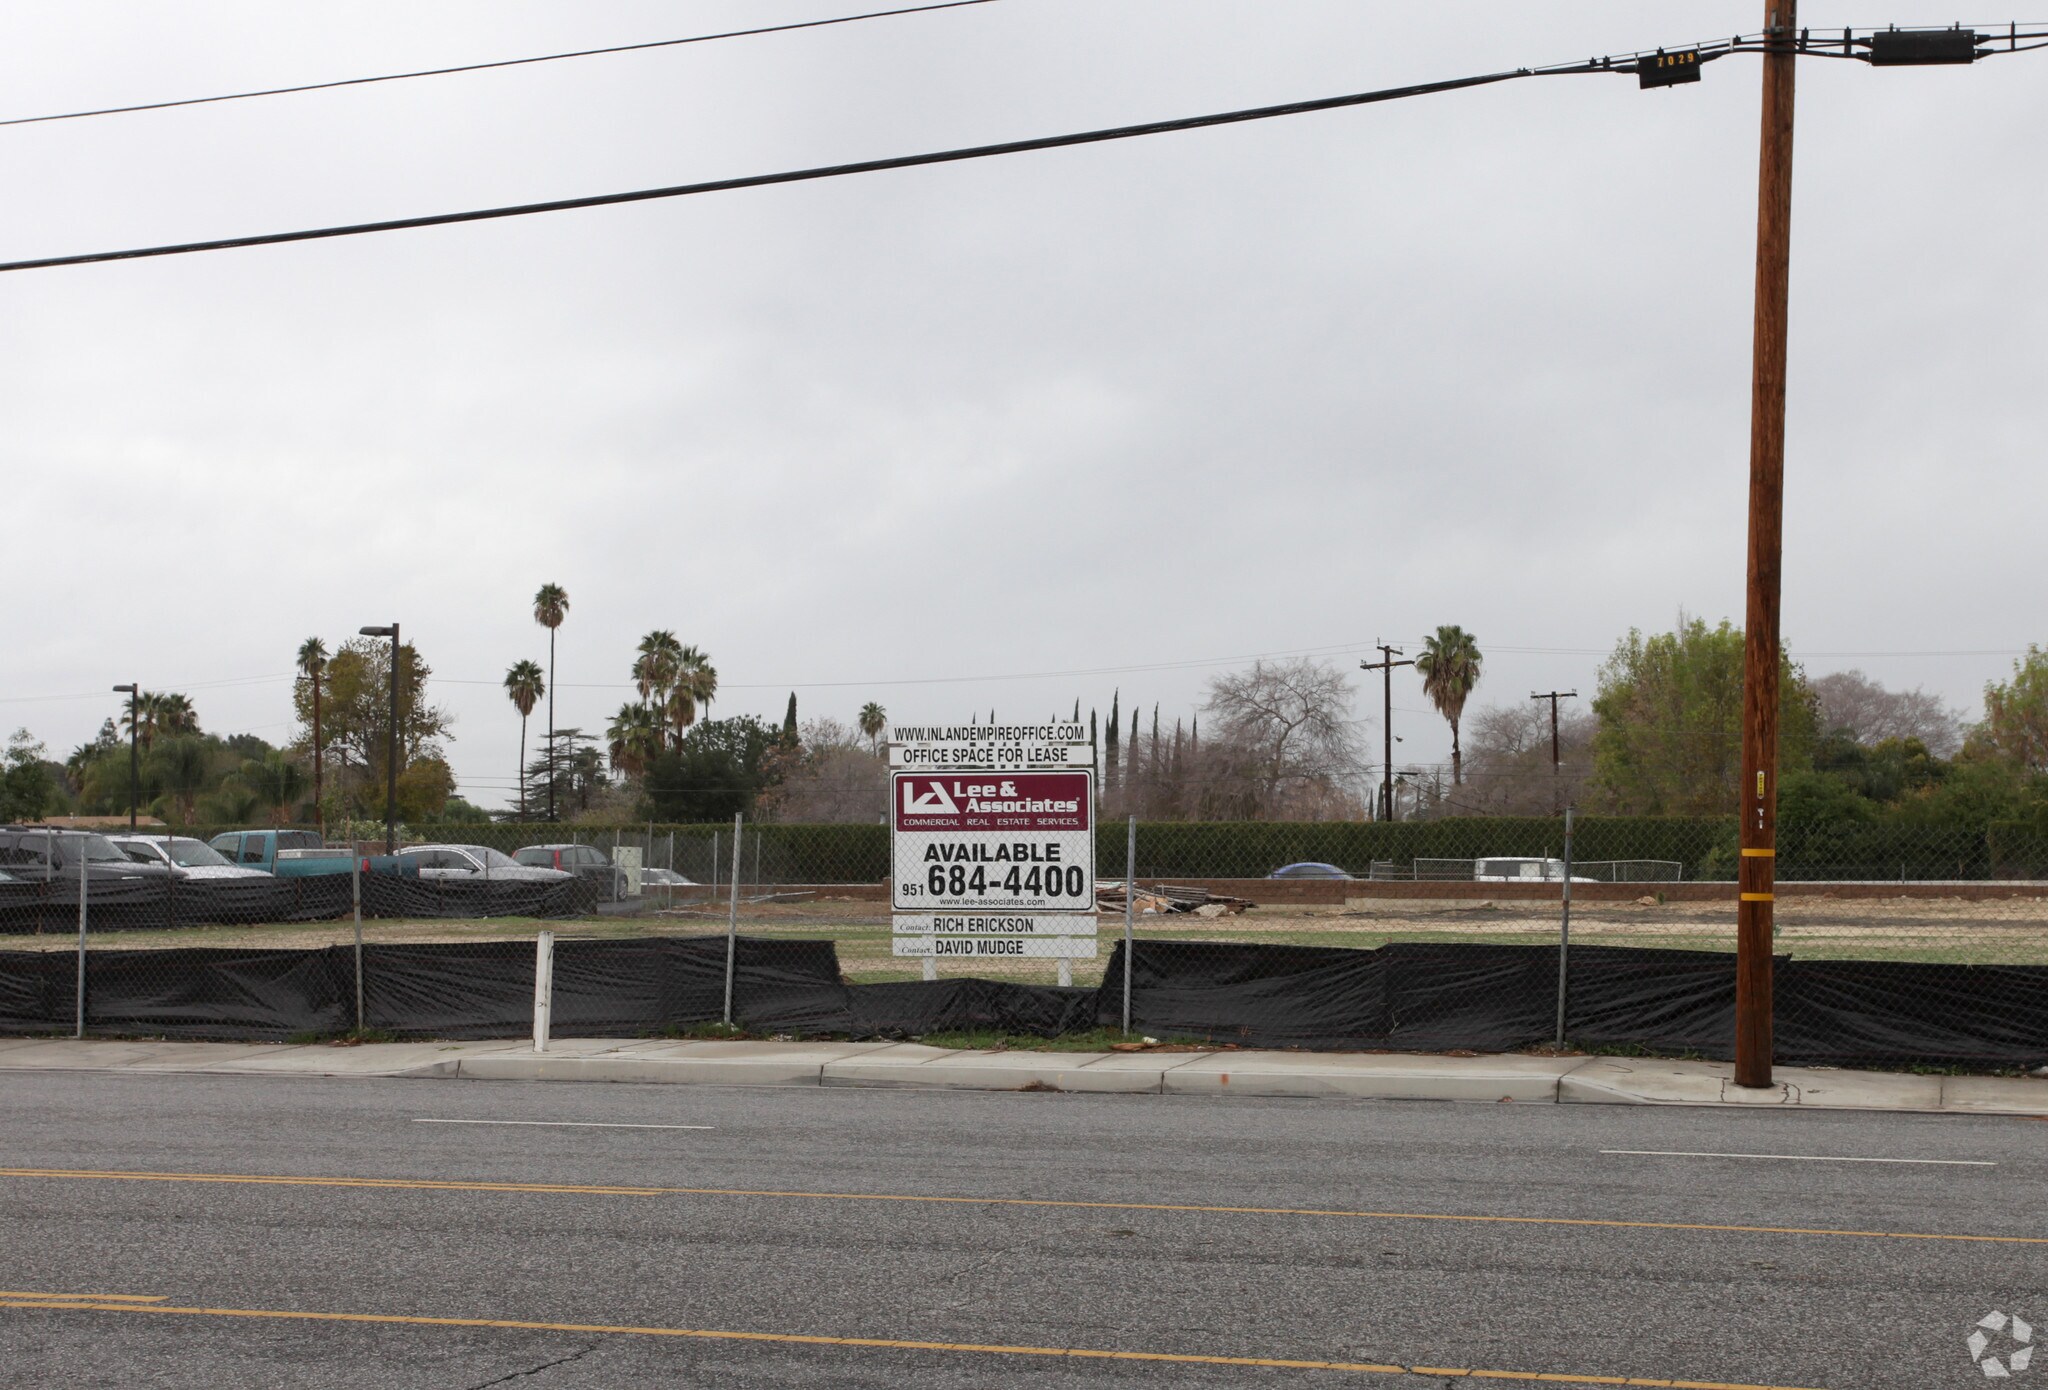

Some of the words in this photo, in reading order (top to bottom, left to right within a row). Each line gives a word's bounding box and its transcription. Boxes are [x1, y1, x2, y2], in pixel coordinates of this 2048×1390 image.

[1657, 52, 1695, 67] 7029
[894, 725, 1084, 741] WWW.INLANDEMPIREOFFICE.COM
[903, 749, 949, 763] OFFICE
[952, 748, 994, 763] SPACE
[997, 748, 1023, 762] FOR
[1027, 747, 1068, 762] LEASE
[953, 781, 997, 797] Lee
[999, 780, 1018, 797] &
[965, 797, 1078, 813] Associates
[903, 818, 960, 826] COMMERCIAL
[966, 818, 990, 826] REAL
[997, 818, 1031, 826] ESTATE
[1036, 817, 1079, 826] SERVICES
[923, 843, 1061, 862] AVAILABLE
[902, 883, 925, 896] 951
[928, 864, 1084, 897] 684-4400
[939, 898, 1046, 907] www.lee-associates.com
[933, 917, 964, 931] RICH
[968, 918, 1034, 932] ERICKSON
[935, 940, 973, 954] DAVID
[977, 940, 1024, 955] MUDGE
